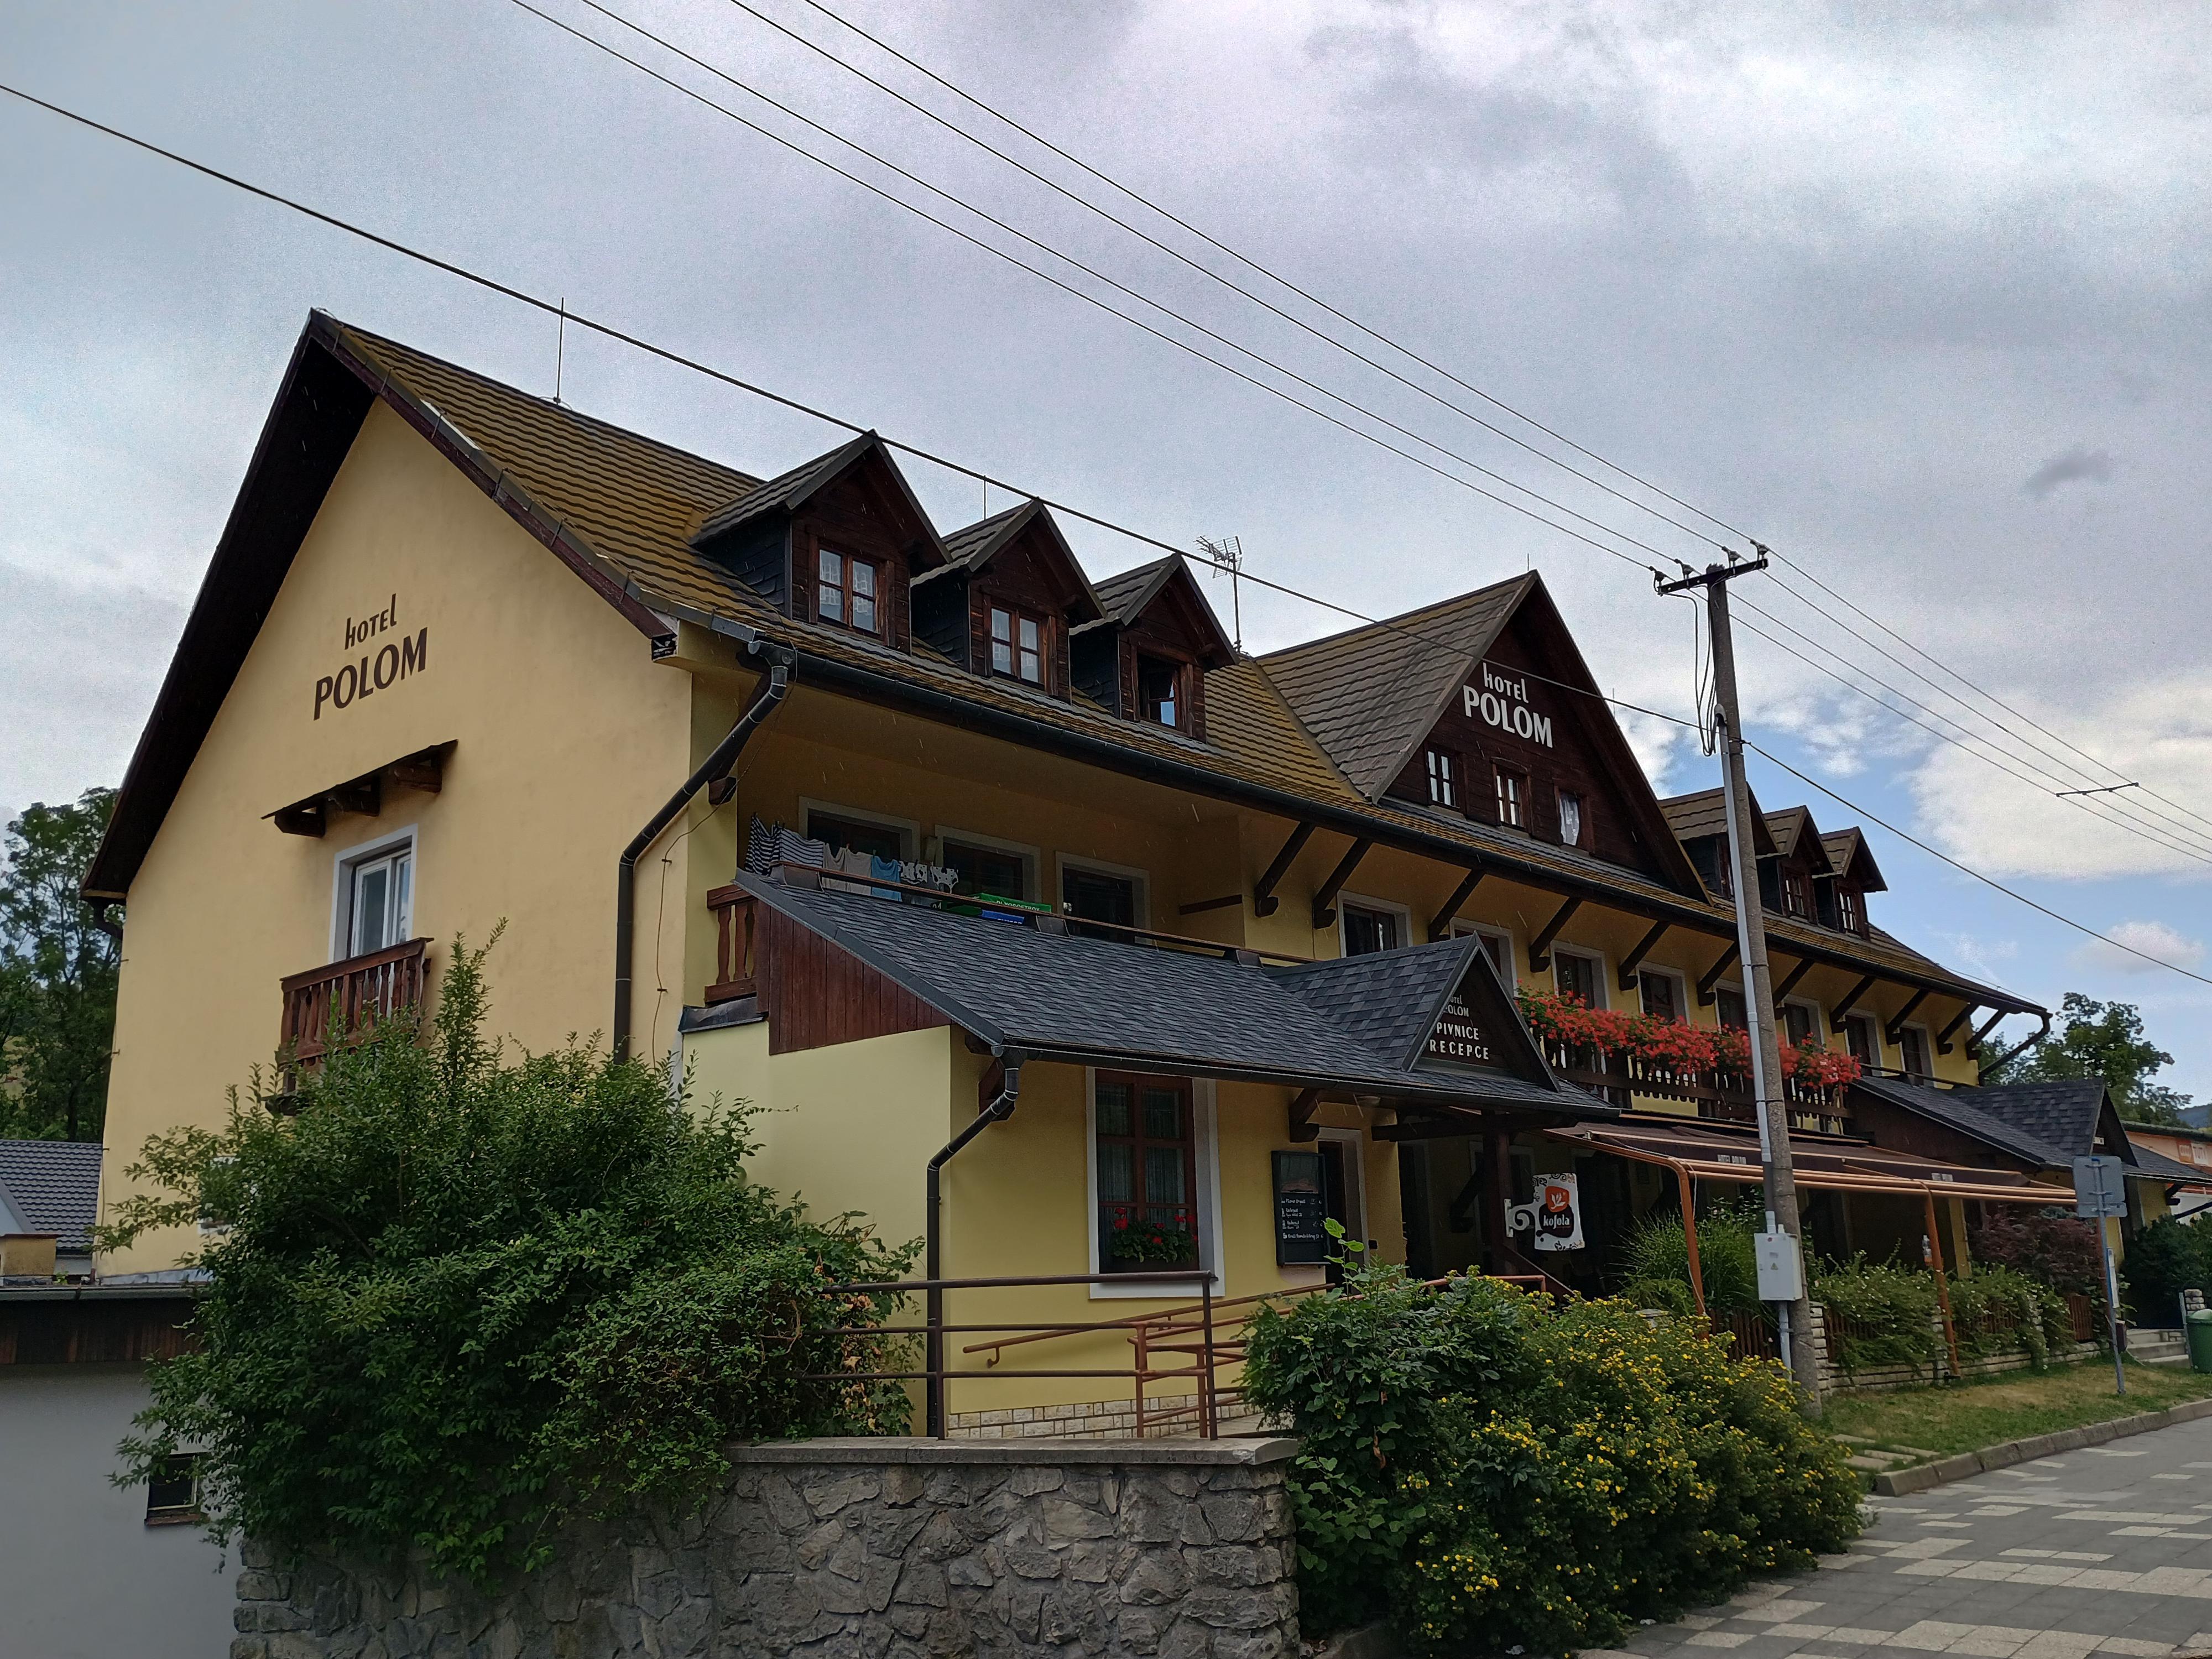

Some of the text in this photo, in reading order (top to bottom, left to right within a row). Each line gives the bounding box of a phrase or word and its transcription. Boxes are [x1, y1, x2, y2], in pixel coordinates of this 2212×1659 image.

[314, 627, 427, 721] POLOM
[1463, 685, 1553, 748] POLOM
[1449, 994, 1463, 1004] OTEL
[1437, 1022, 1479, 1040] PIVNICE
[1430, 1039, 1489, 1060] RECEPCE
[1543, 1214, 1570, 1229] kofola
